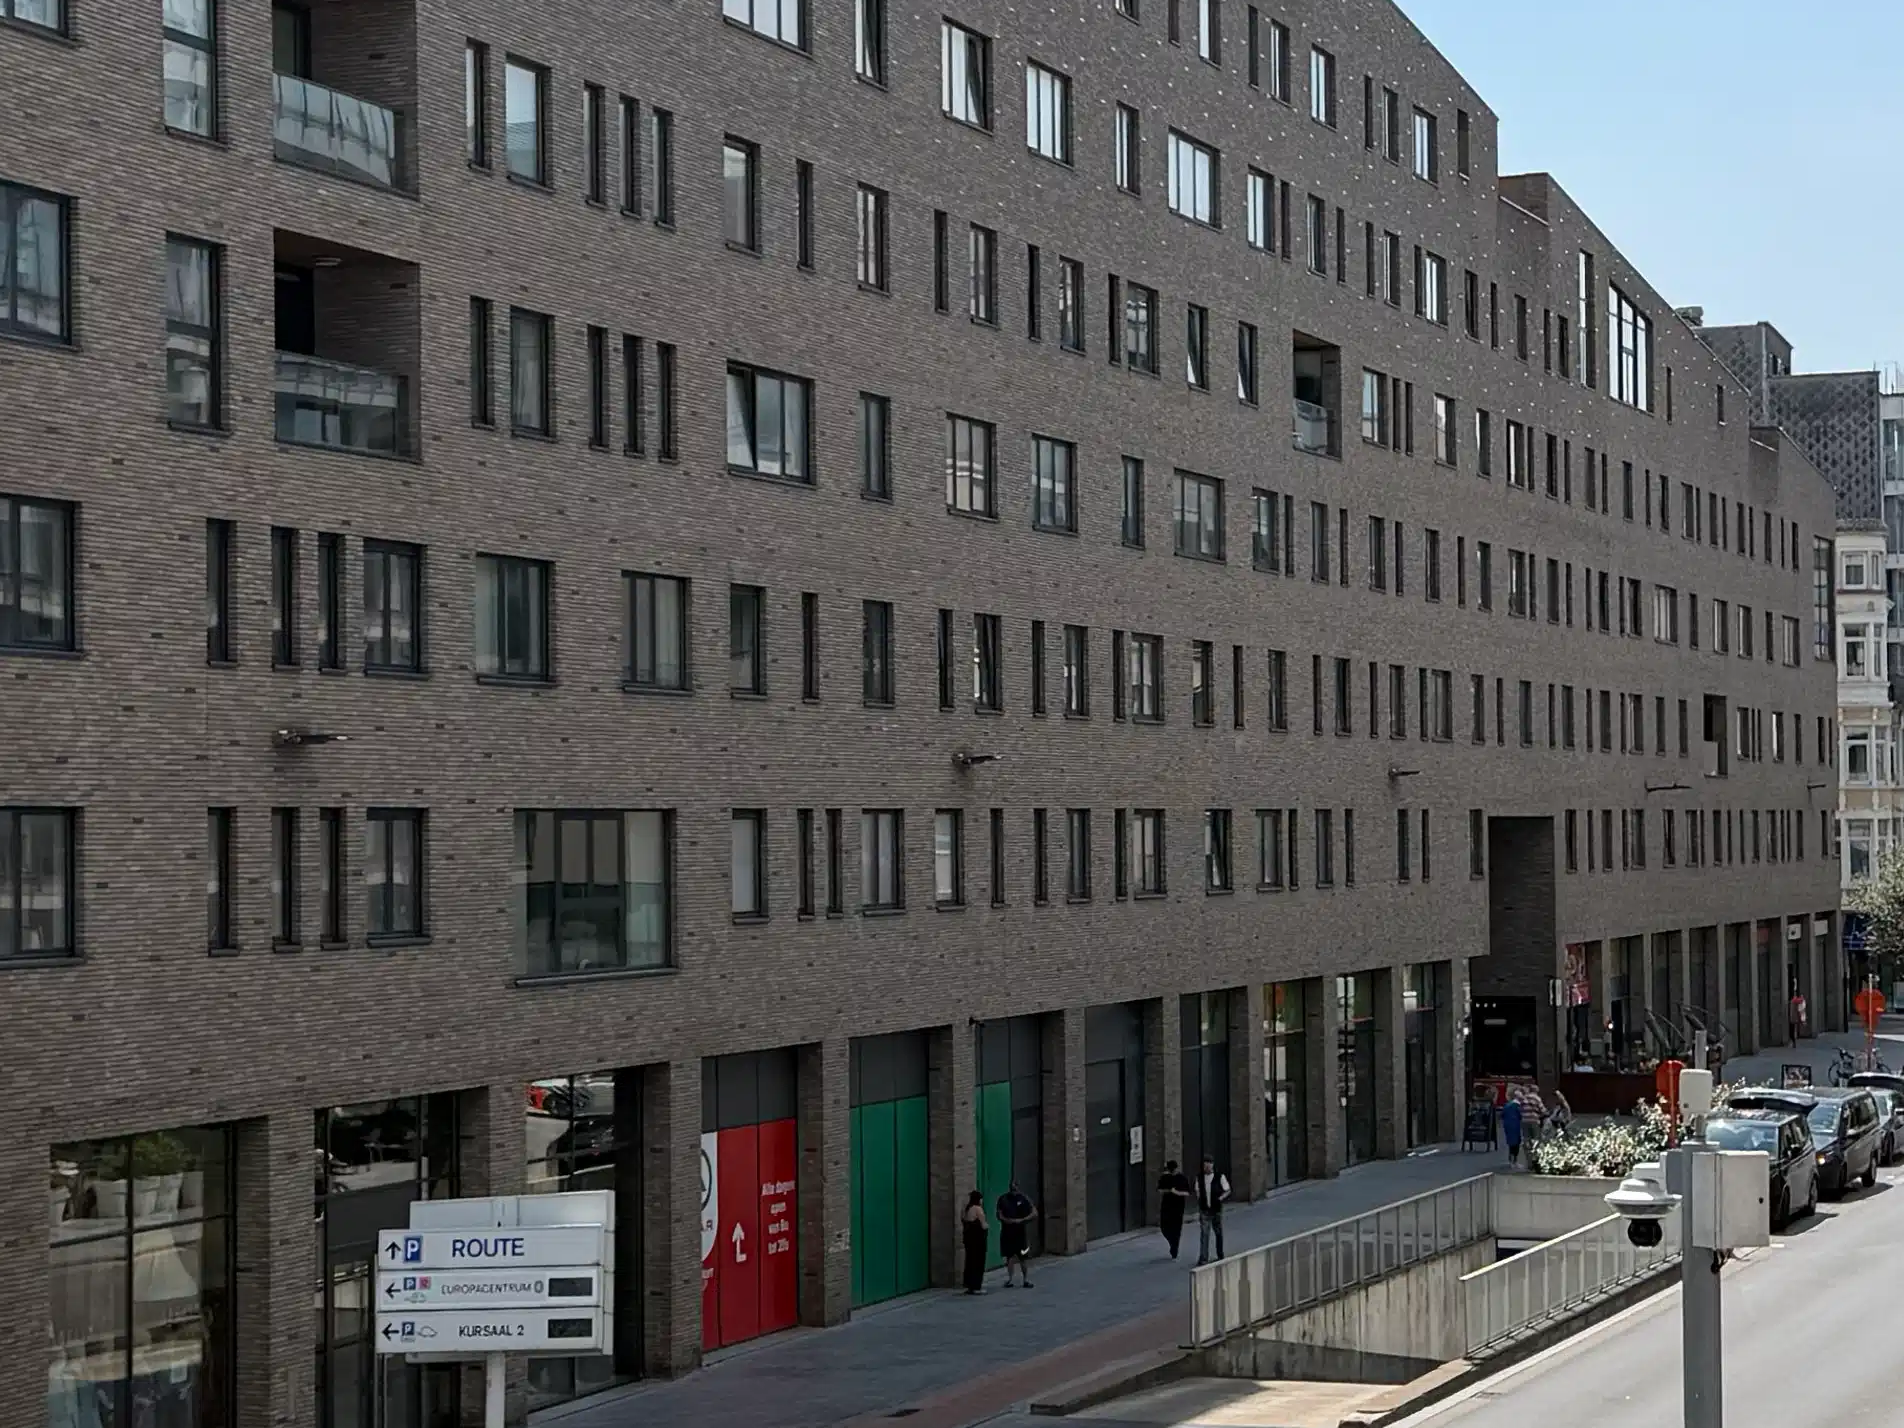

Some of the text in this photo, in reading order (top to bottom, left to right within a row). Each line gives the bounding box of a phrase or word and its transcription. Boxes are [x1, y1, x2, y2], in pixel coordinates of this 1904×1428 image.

[407, 1238, 525, 1259] P ROUTE
[459, 1325, 512, 1337] KURSAAL
[518, 1325, 525, 1336] 2
